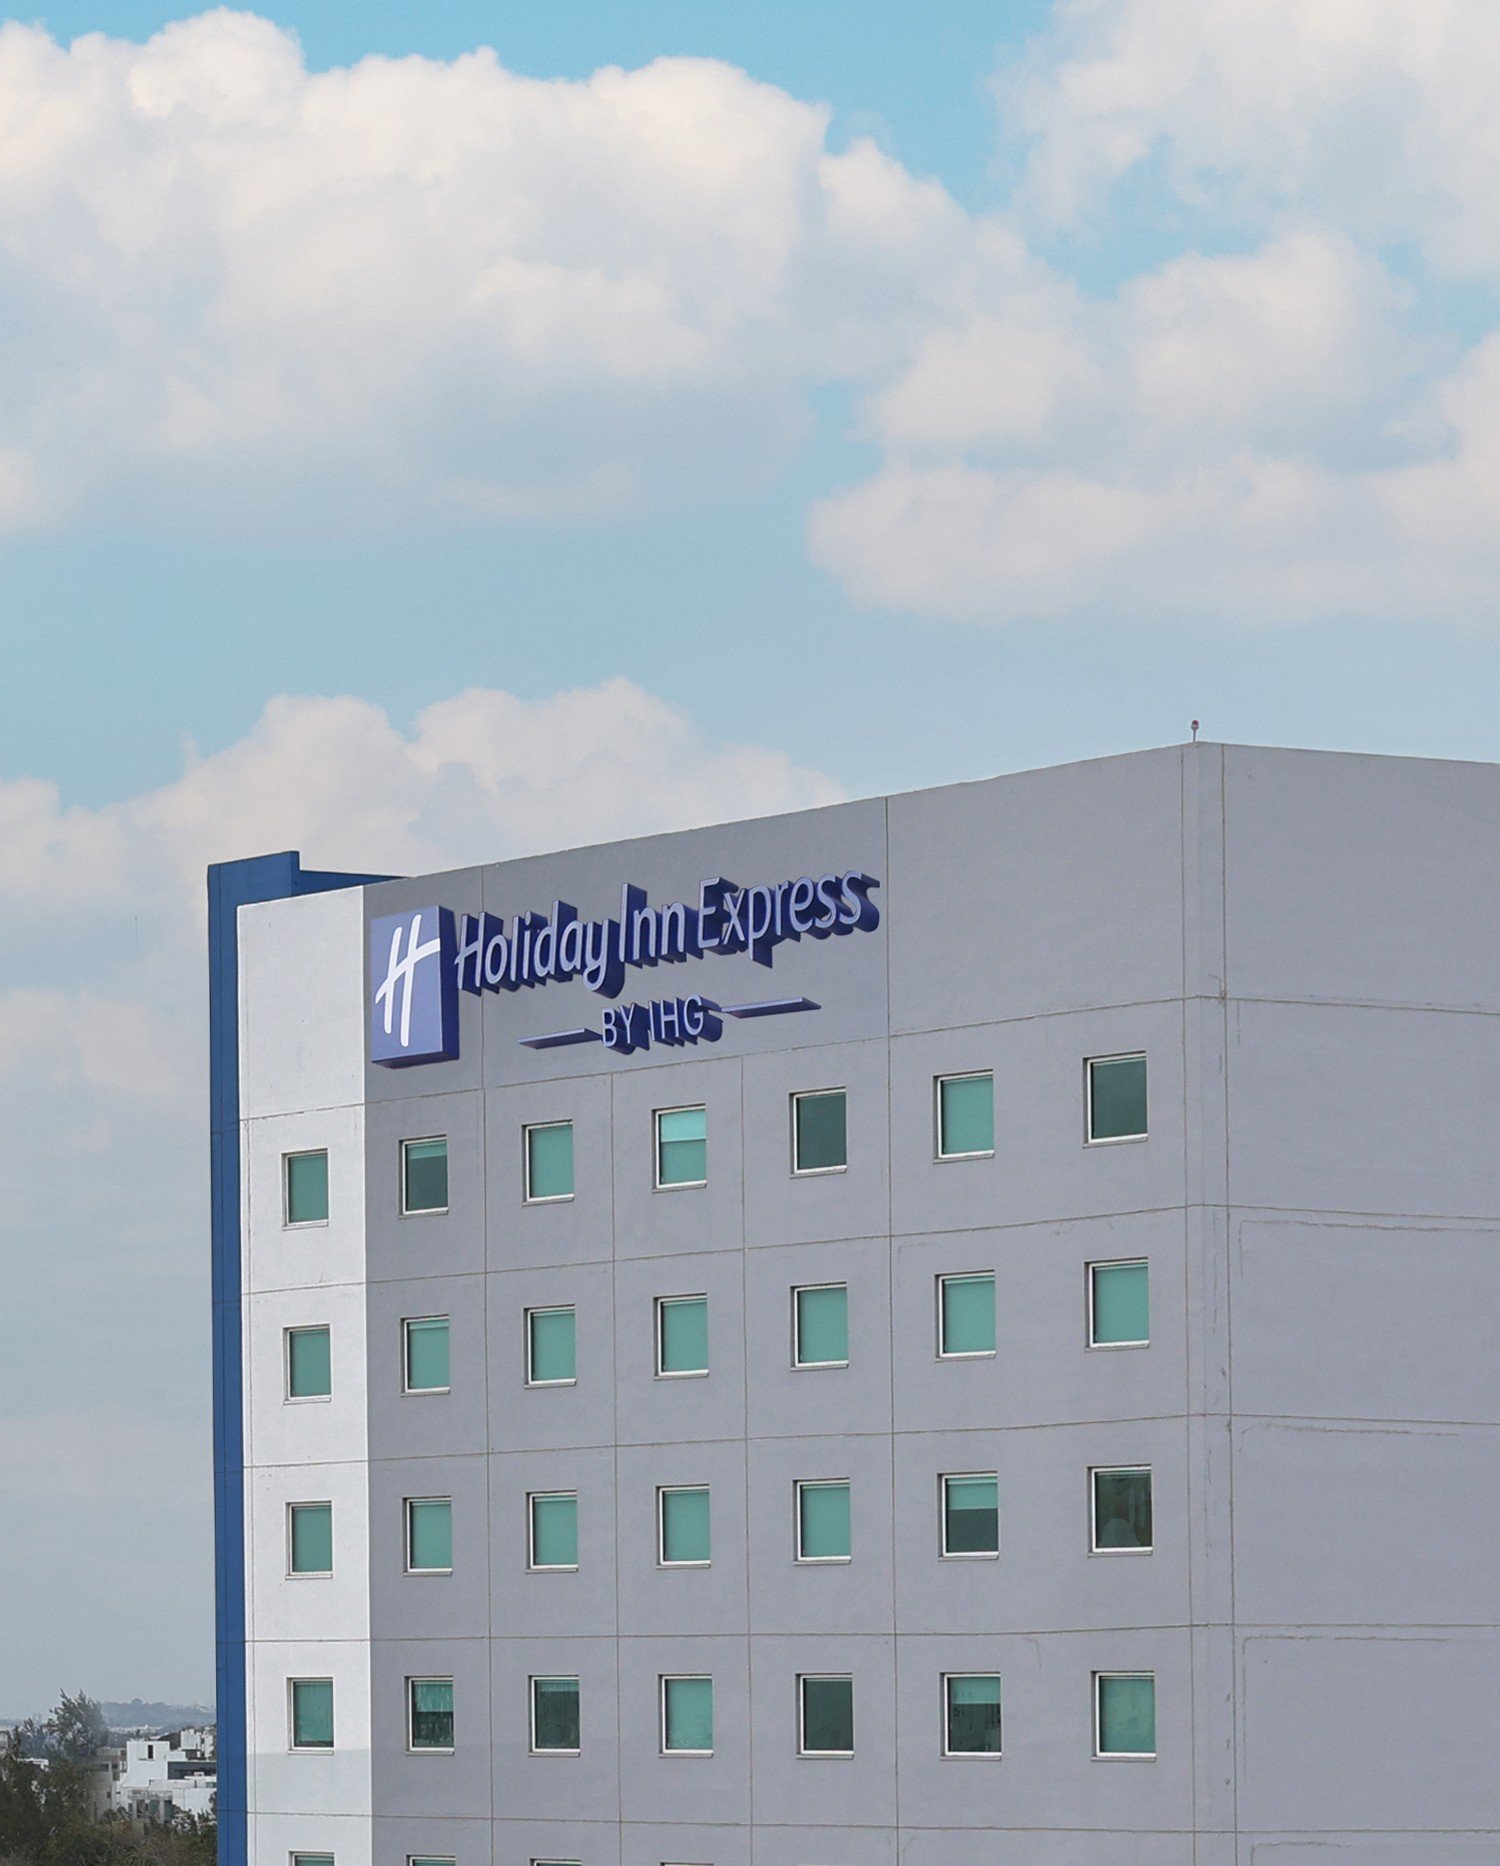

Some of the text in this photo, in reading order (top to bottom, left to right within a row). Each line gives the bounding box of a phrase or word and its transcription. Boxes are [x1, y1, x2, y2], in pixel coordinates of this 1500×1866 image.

[454, 869, 873, 996] Holiday Inn Express
[601, 993, 713, 1050] BY IHG
